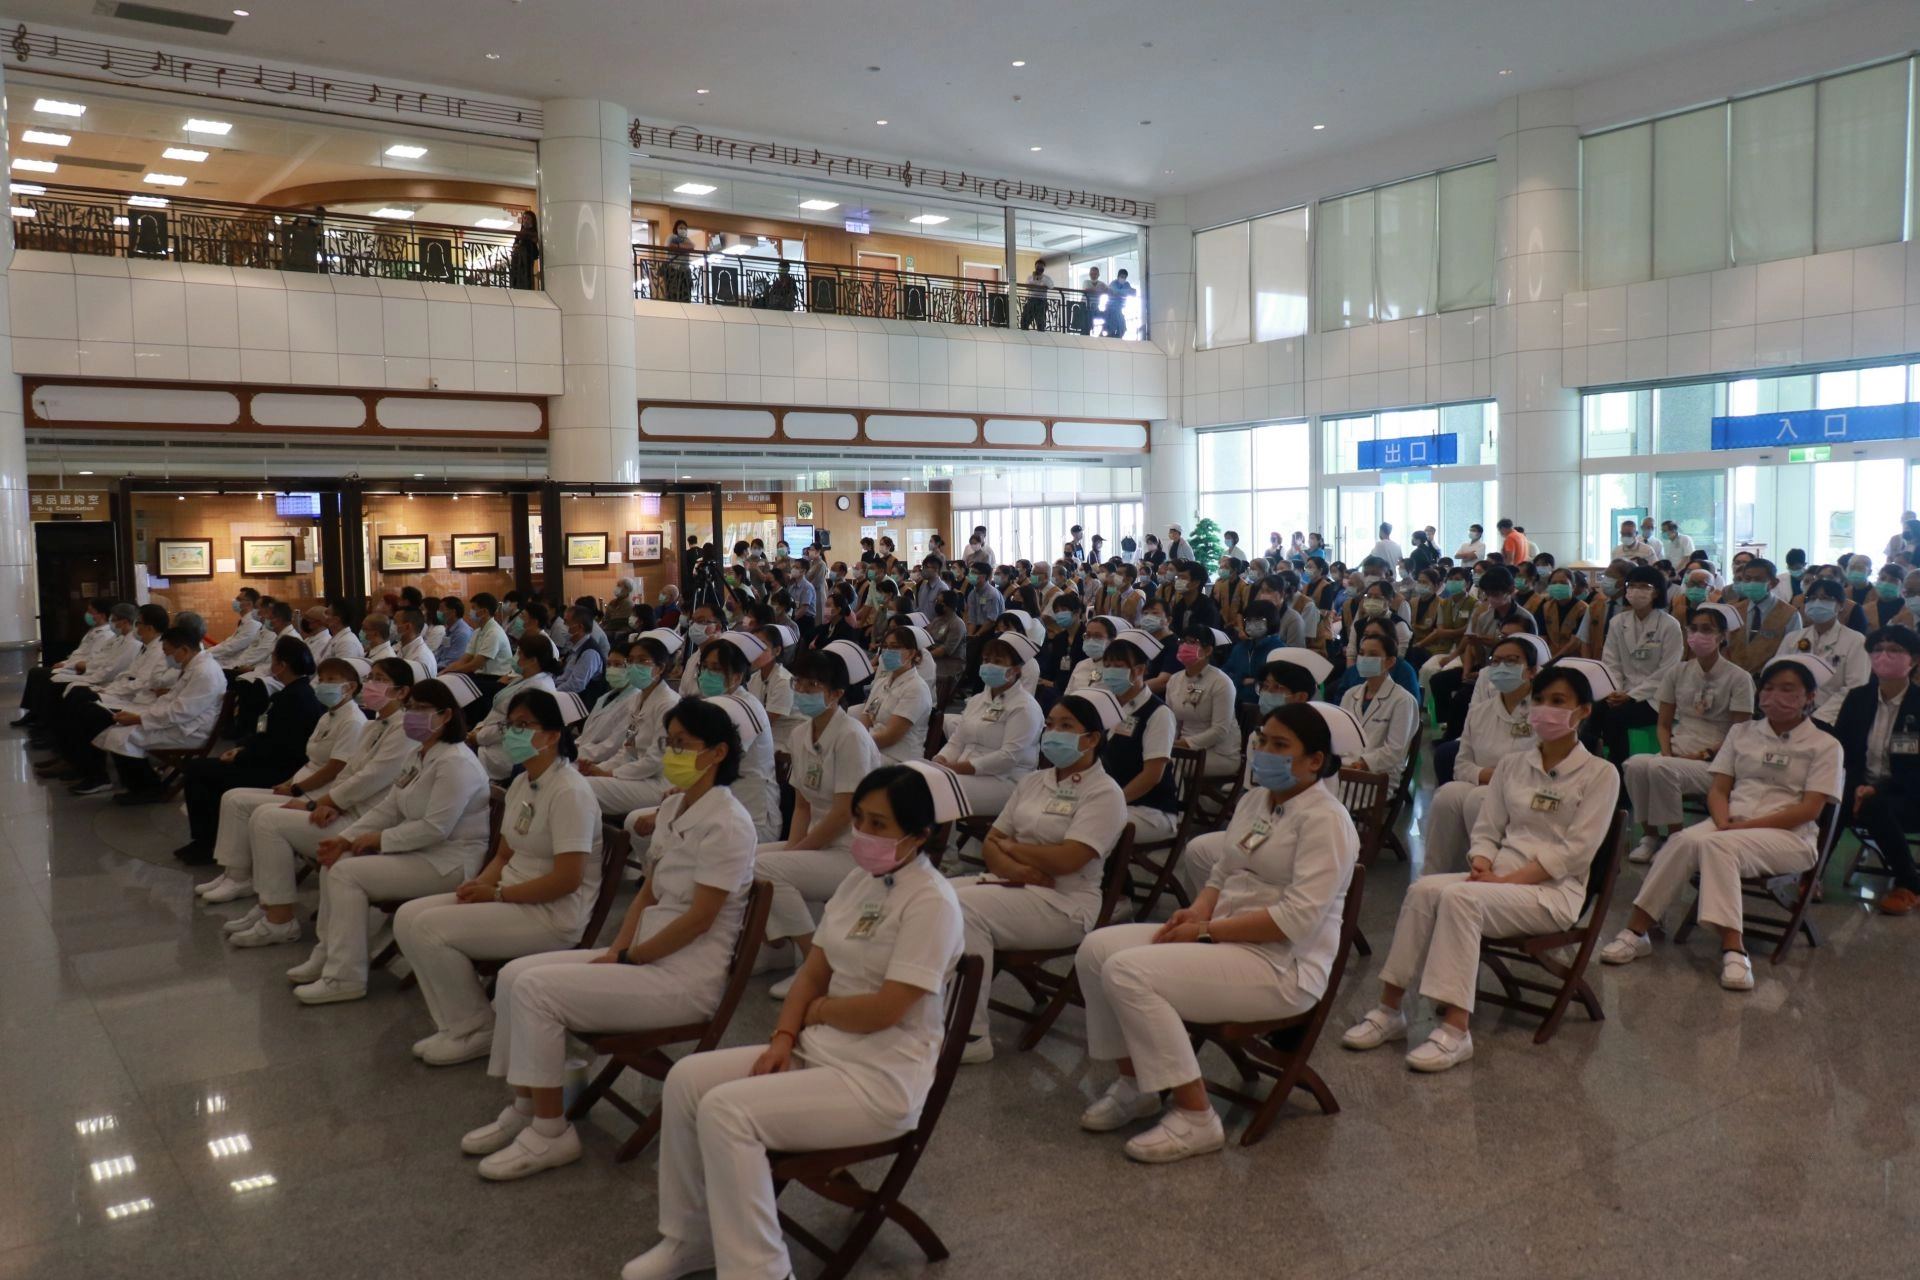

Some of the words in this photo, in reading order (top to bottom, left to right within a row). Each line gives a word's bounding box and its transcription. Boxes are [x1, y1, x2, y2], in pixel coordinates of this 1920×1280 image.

[1776, 414, 1847, 439] 入口
[1385, 441, 1426, 463] 出口
[727, 493, 733, 502] 8
